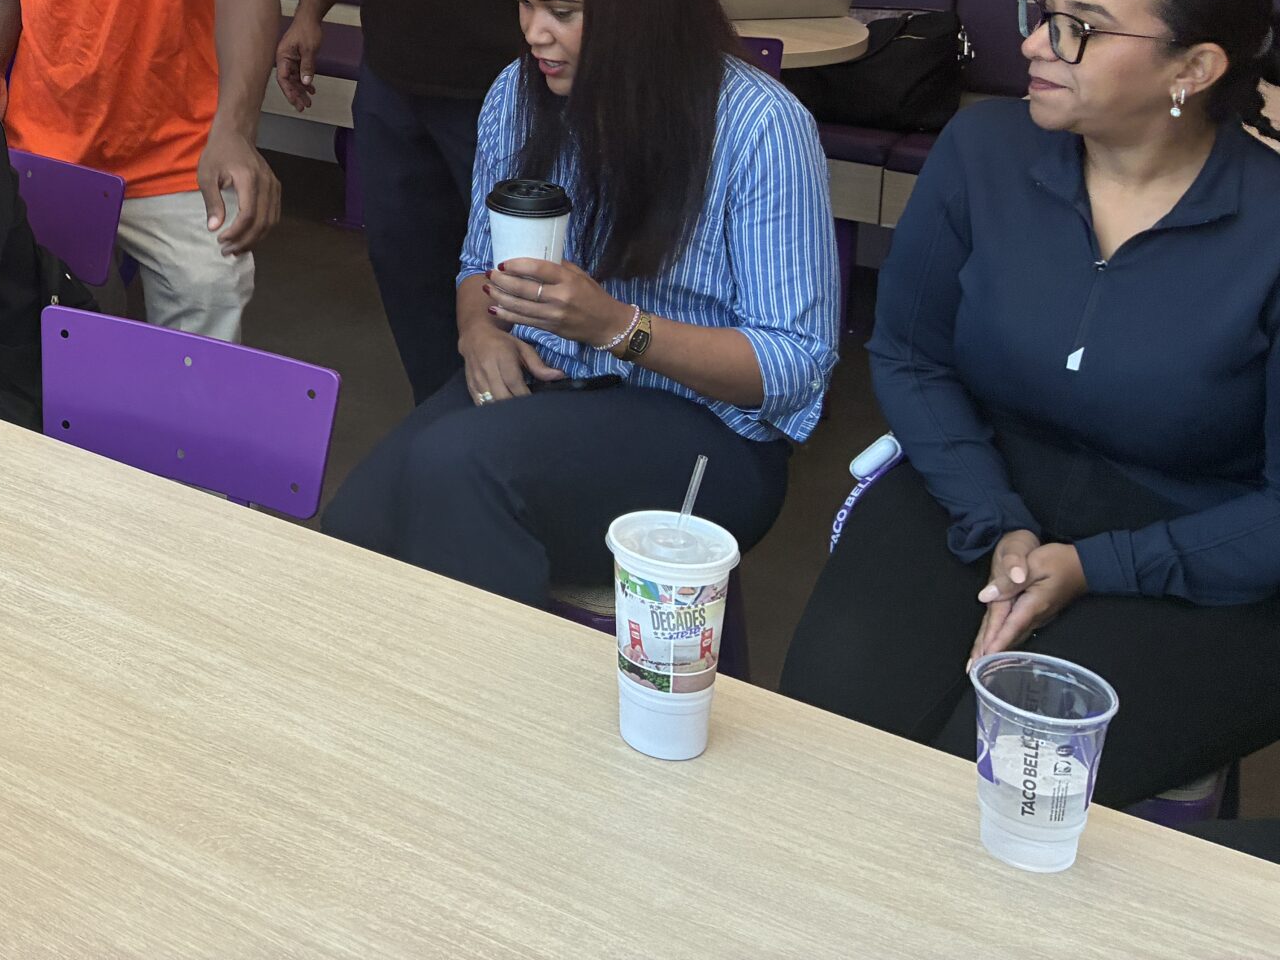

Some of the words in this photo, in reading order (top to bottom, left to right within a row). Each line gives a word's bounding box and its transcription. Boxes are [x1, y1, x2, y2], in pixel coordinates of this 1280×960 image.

[844, 471, 880, 507] BELL
[650, 607, 706, 632] DECADES
[1023, 739, 1040, 778] BELL
[1021, 779, 1037, 816] TACO
